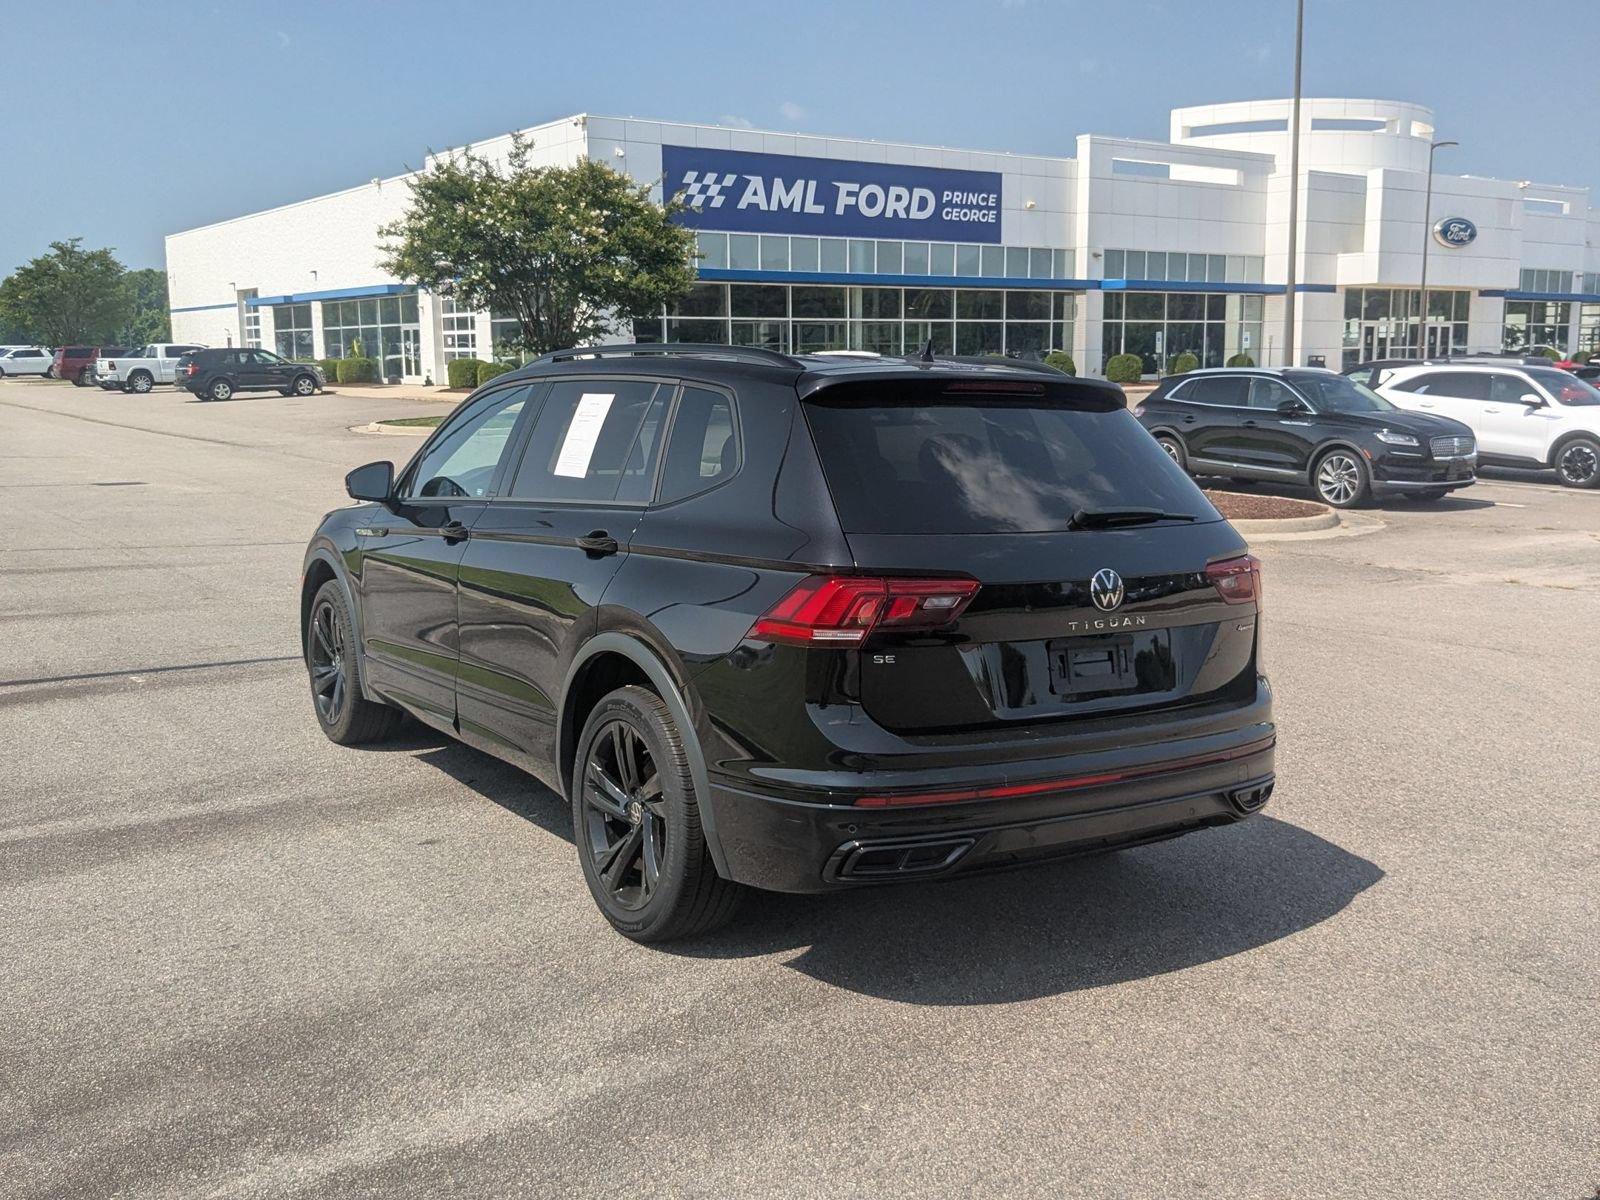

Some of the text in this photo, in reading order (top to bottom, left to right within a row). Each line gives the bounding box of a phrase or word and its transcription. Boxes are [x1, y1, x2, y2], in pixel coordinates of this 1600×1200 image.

[737, 174, 936, 220] AML FORD
[942, 191, 997, 206] PRINCE
[942, 208, 997, 223] GEORGE
[1447, 223, 1471, 241] Ford
[1068, 616, 1145, 631] TIGUAN
[873, 655, 896, 664] SE
